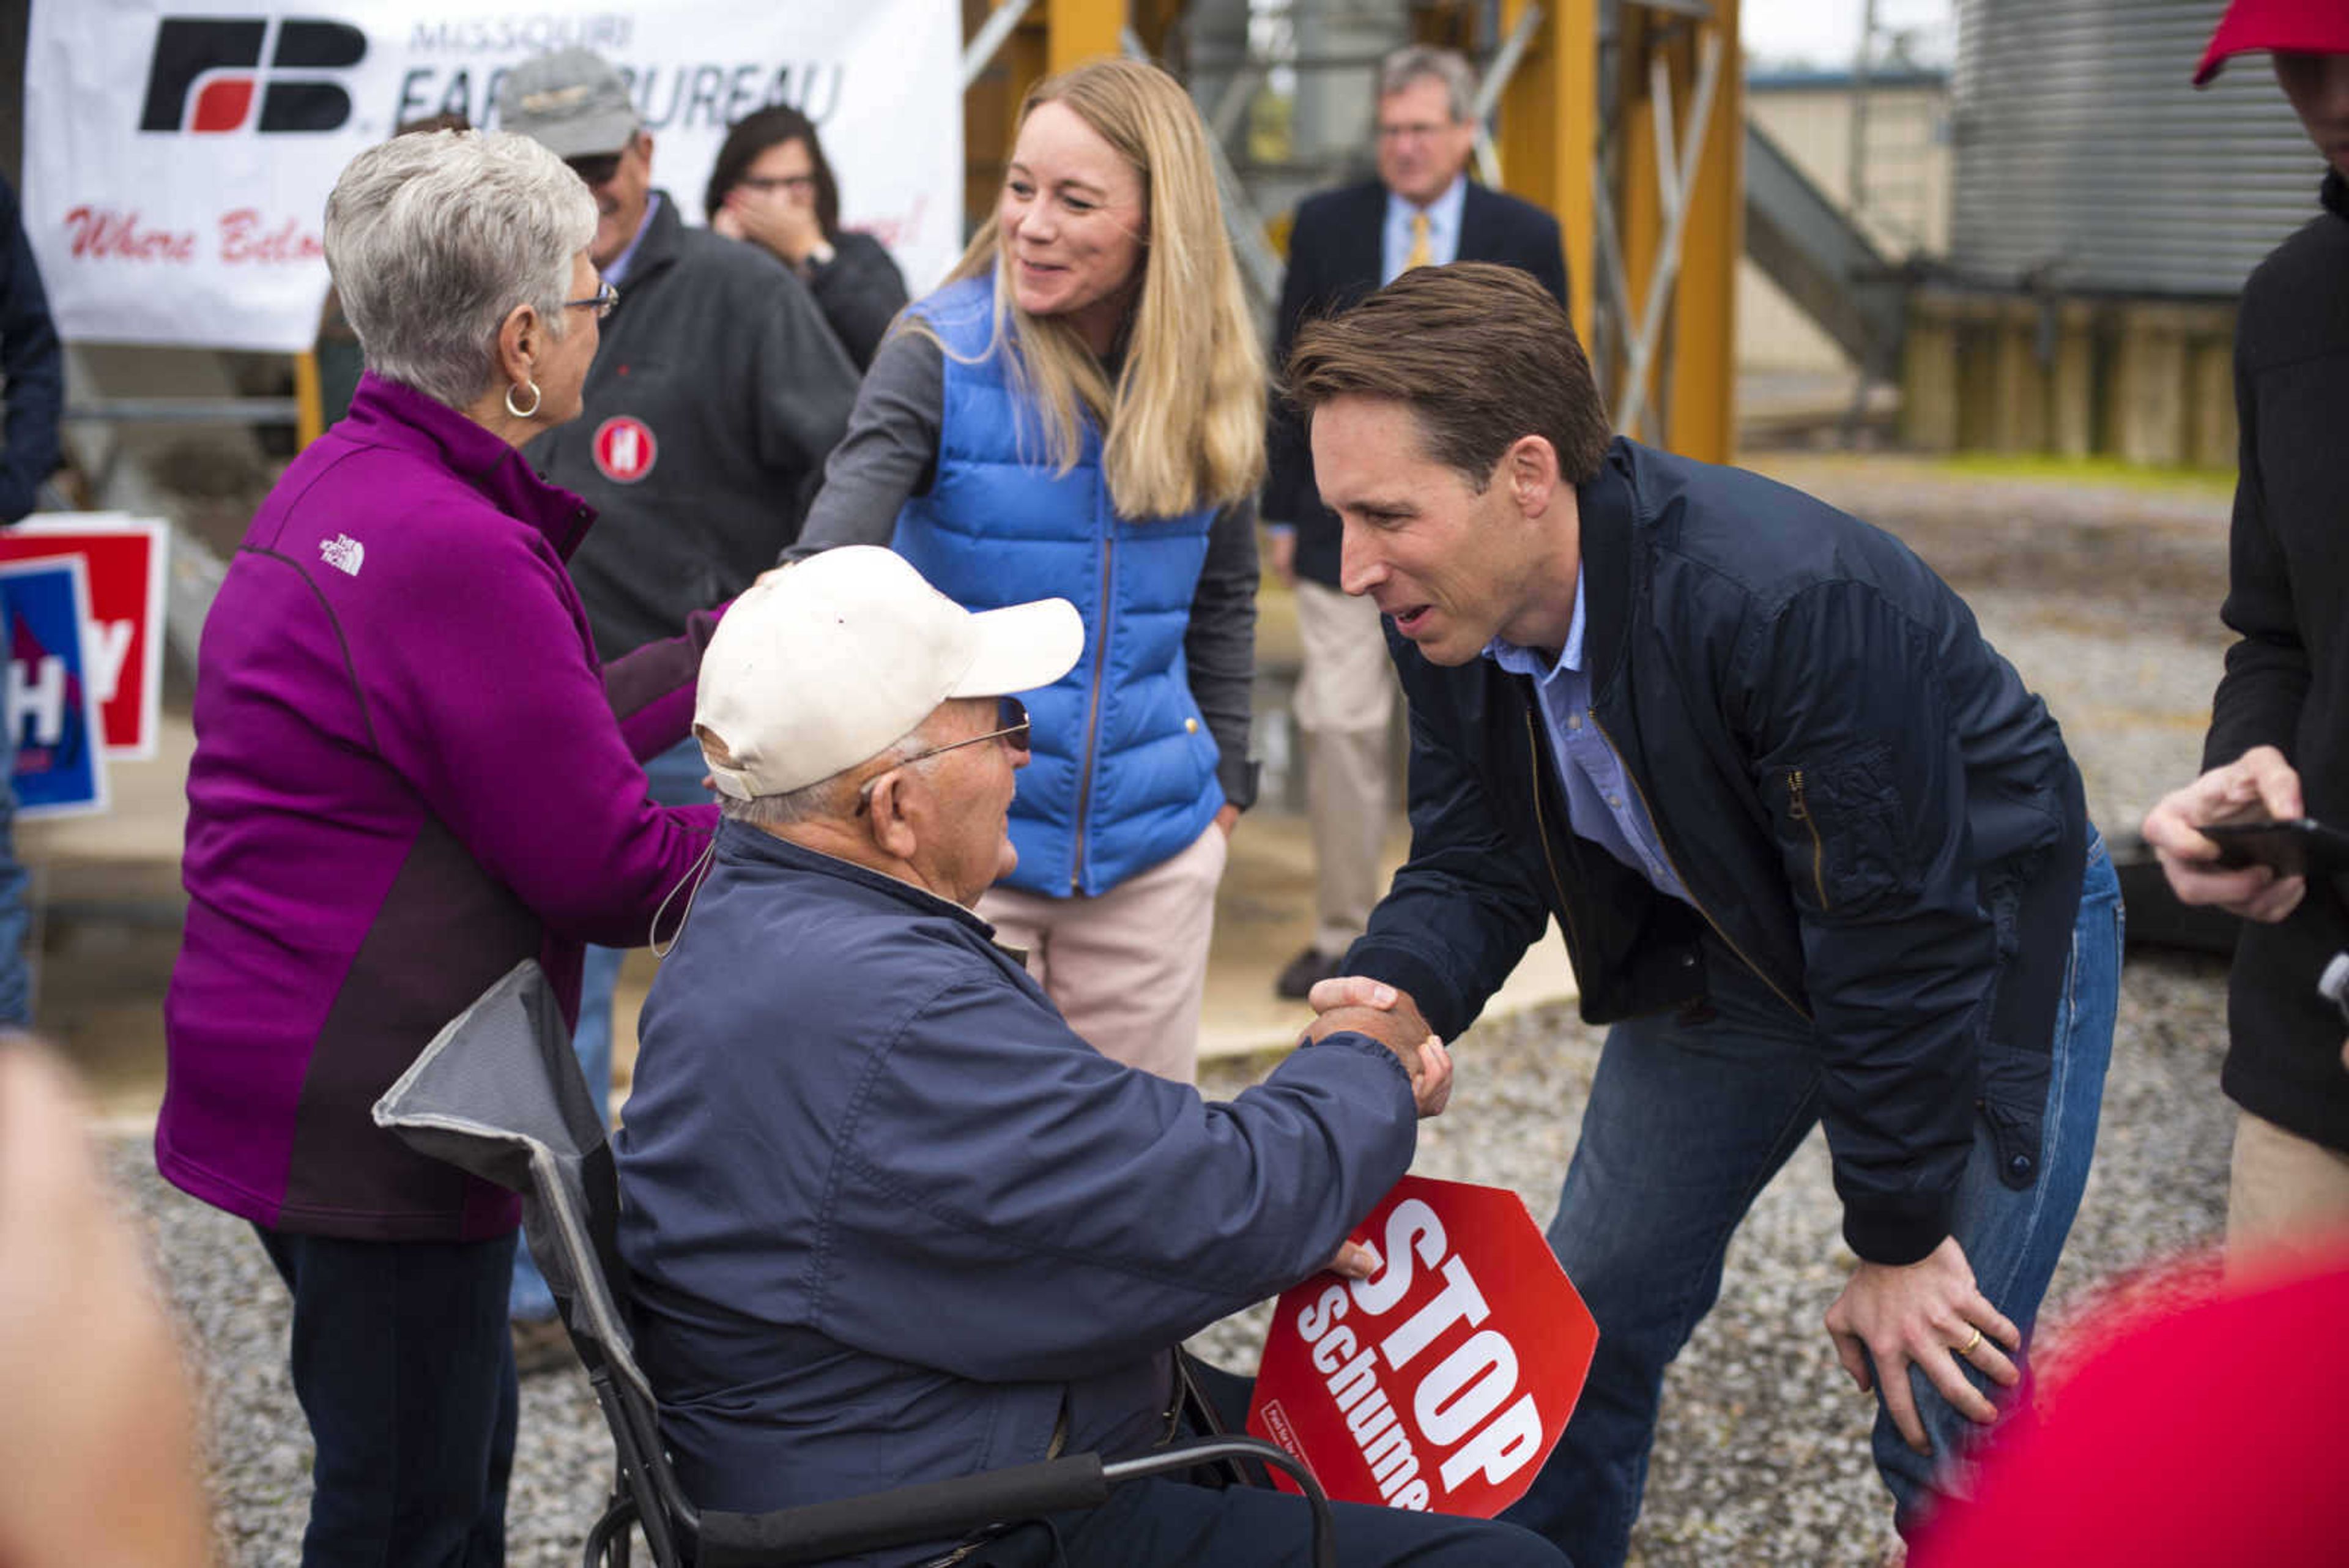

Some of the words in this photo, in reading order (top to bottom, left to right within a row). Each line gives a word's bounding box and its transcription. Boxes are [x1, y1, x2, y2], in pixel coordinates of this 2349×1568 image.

[65, 207, 195, 262] Where
[1296, 1284, 1434, 1513] Schume
[1349, 1198, 1543, 1495] STOP
